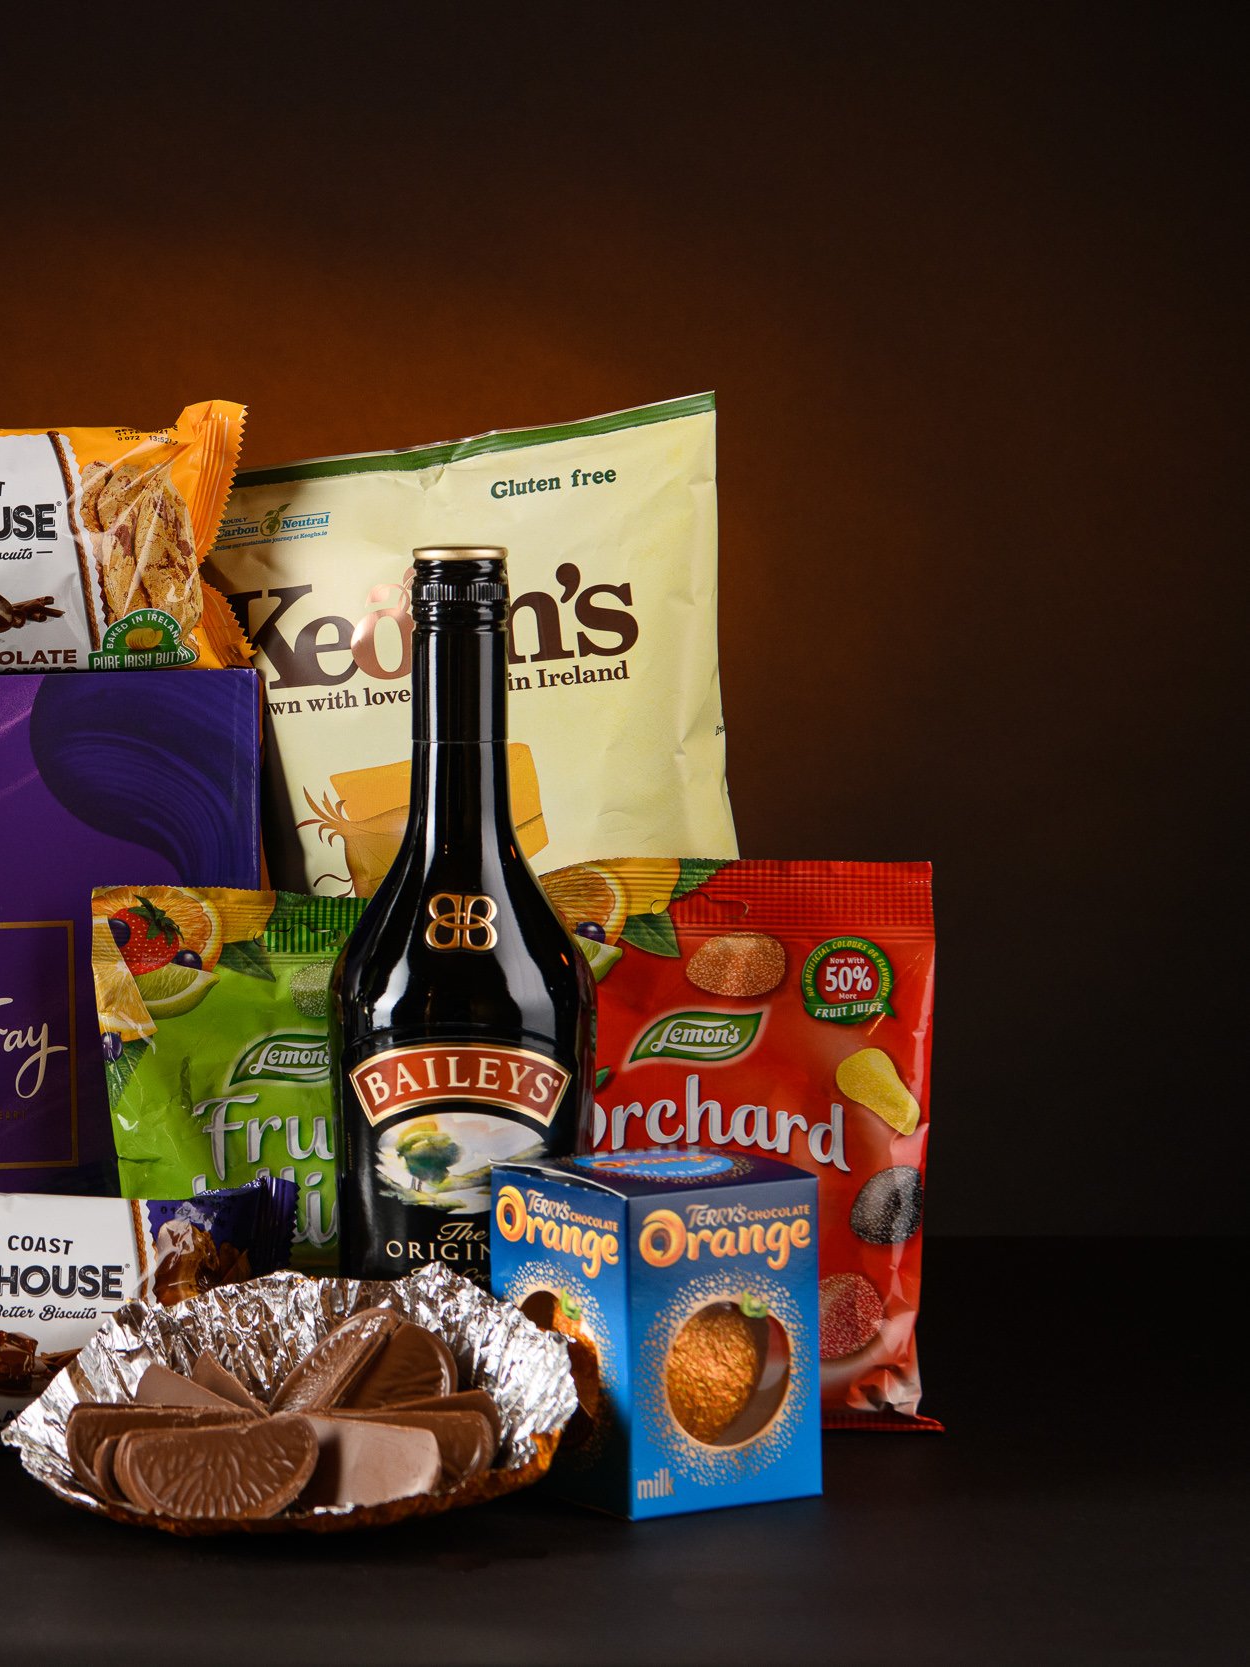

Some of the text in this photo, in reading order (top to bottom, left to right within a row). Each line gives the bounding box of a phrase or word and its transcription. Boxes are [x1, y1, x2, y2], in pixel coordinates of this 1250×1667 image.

[491, 468, 617, 499] Gluten free
[281, 514, 330, 530] Neutral
[106, 622, 129, 649] BAKED
[131, 614, 143, 625] IN
[93, 654, 120, 670] PURE
[124, 653, 152, 668] IRISH
[307, 689, 358, 712] with
[363, 687, 411, 706] love
[508, 672, 532, 691] in
[536, 660, 630, 689] Ireland
[804, 940, 891, 997] NO ARTIFICIAL COLOURS OR FLAVOURS
[825, 965, 872, 992] 50%
[814, 1002, 884, 1018] FRUIT JUICE
[650, 1019, 741, 1053] Lemon's
[364, 1056, 554, 1107] BAILEYS
[526, 1189, 619, 1232] TERRY'S CHOCOLATE
[686, 1203, 811, 1228] TERRY'S CHOCOLATE
[7, 1235, 74, 1255] COAST
[437, 1222, 488, 1241] The
[496, 1185, 619, 1279] Orange
[639, 1208, 811, 1271] Orange
[386, 1240, 491, 1260] ORIGIN
[39, 1304, 97, 1321] Biscuits
[637, 1467, 675, 1500] milk
